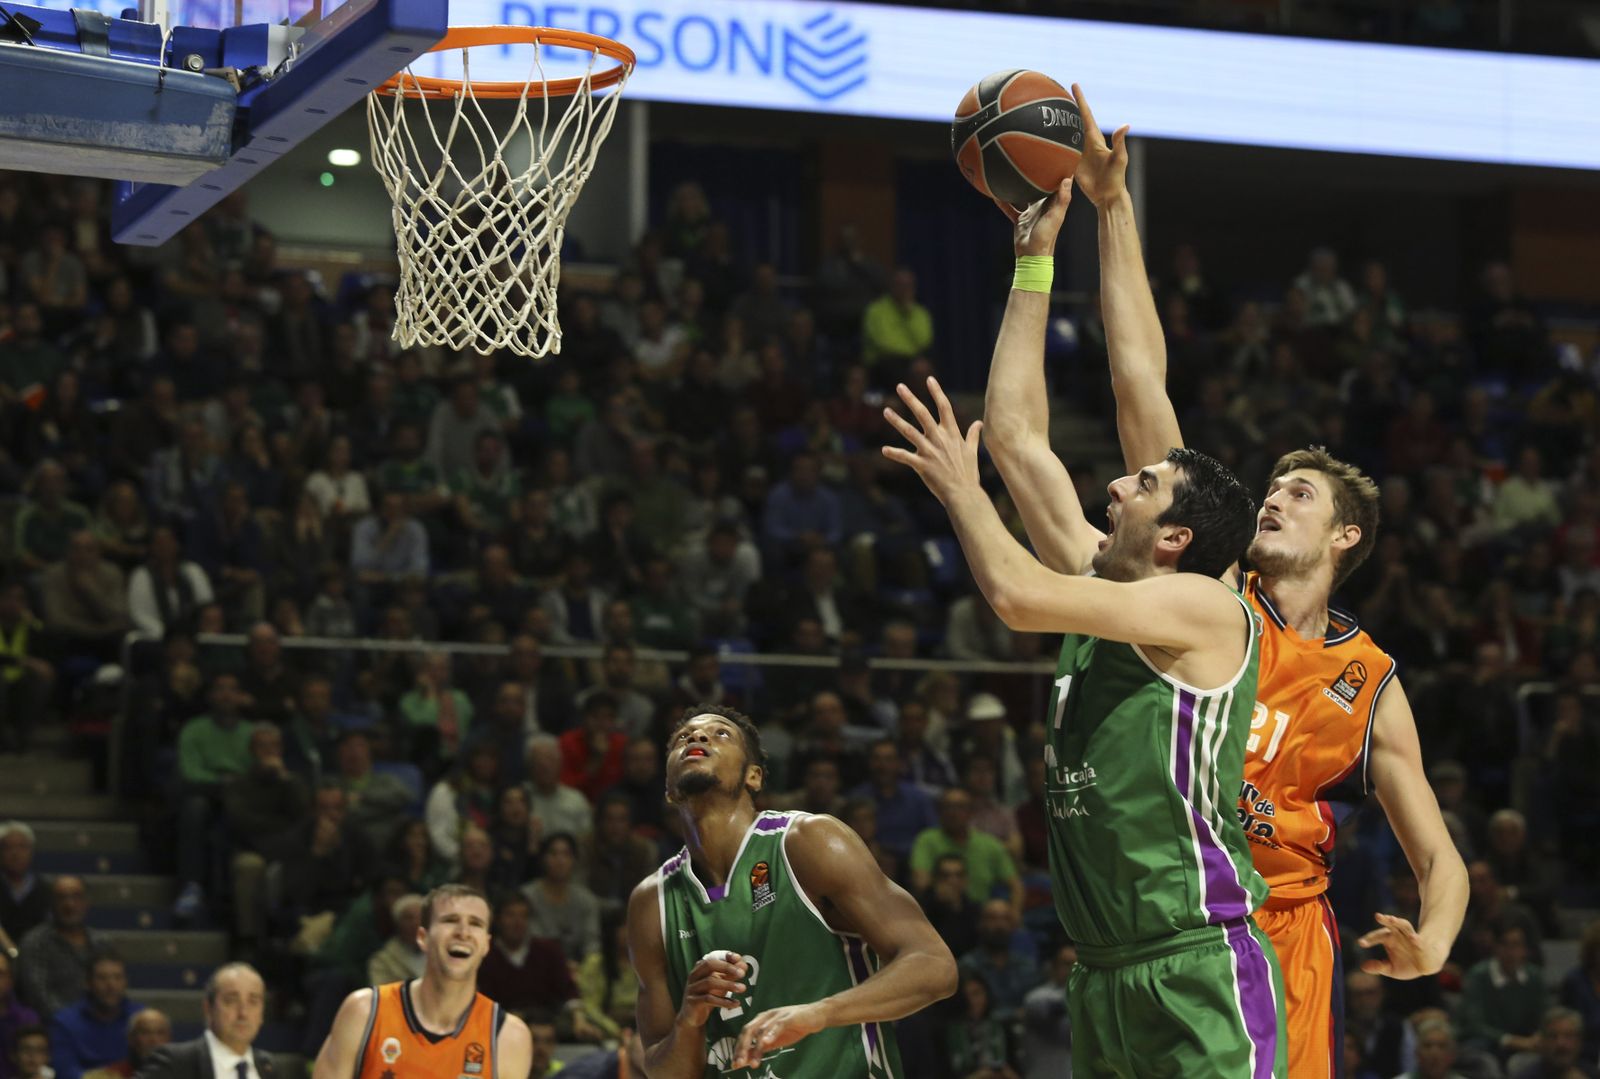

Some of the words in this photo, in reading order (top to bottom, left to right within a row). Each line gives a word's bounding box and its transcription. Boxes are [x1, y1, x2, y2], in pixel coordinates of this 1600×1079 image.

[500, 2, 774, 77] PERSON
[1054, 674, 1073, 729] 1
[1246, 700, 1290, 764] 21
